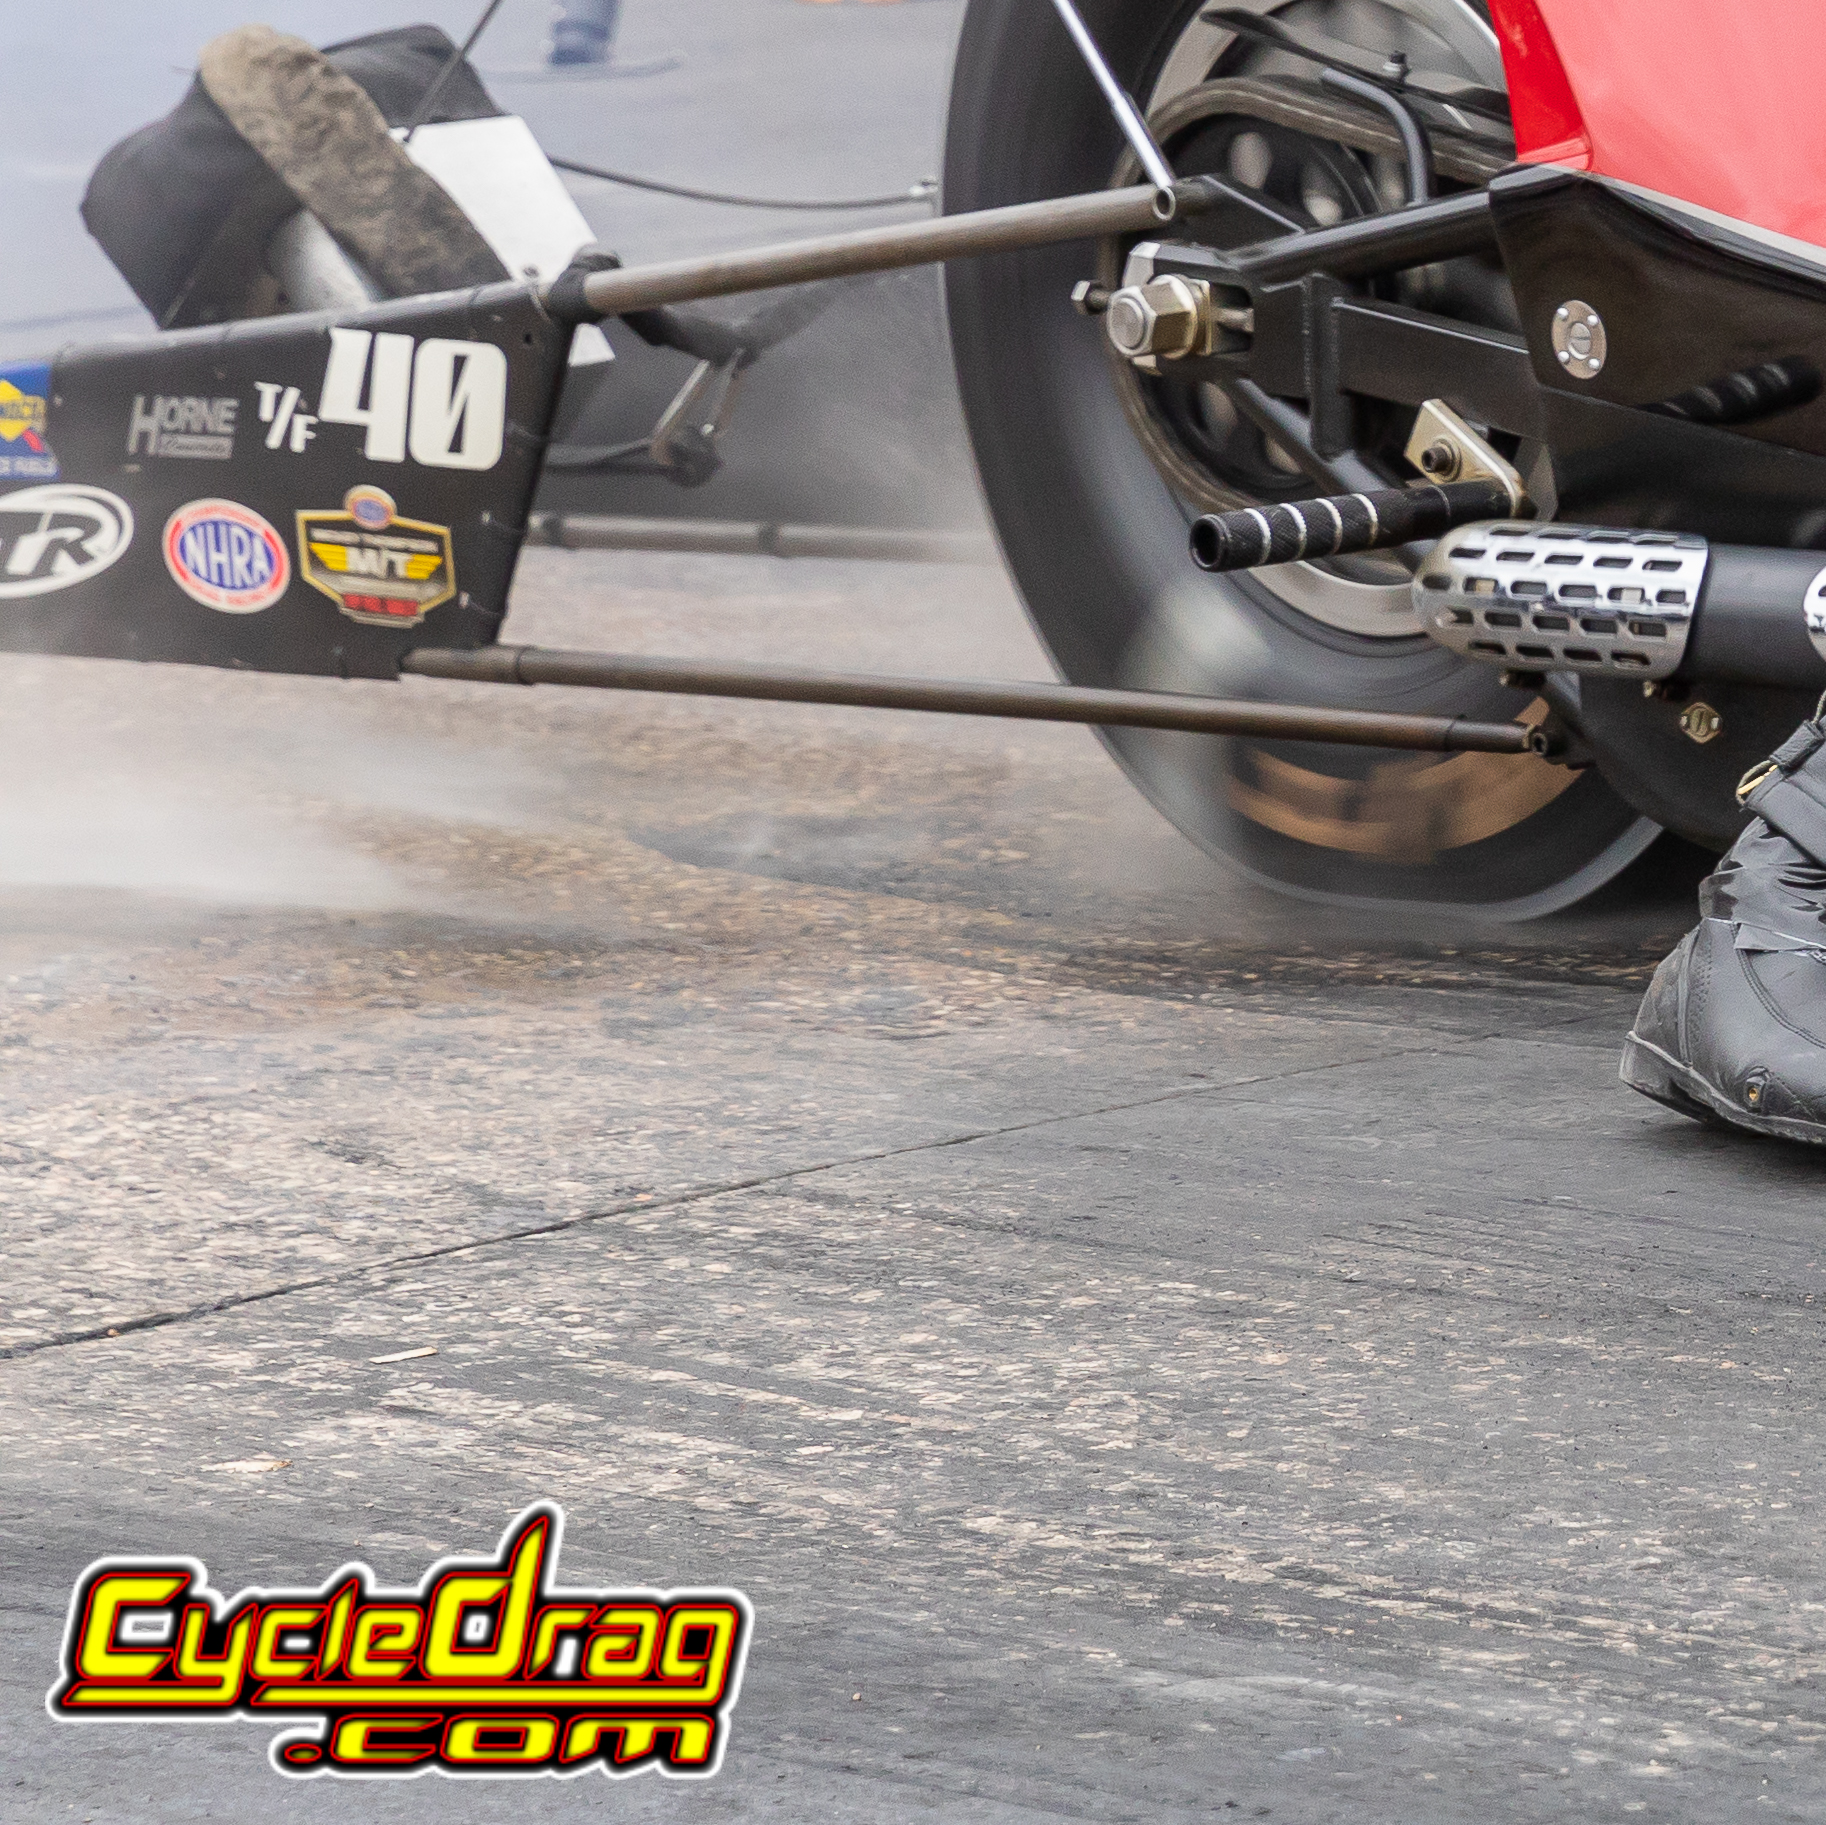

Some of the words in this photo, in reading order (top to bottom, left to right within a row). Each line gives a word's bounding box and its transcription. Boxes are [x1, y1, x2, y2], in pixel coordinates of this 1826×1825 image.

[127, 394, 240, 455] HORNE
[318, 326, 509, 472] 40
[183, 522, 273, 590] NHRA
